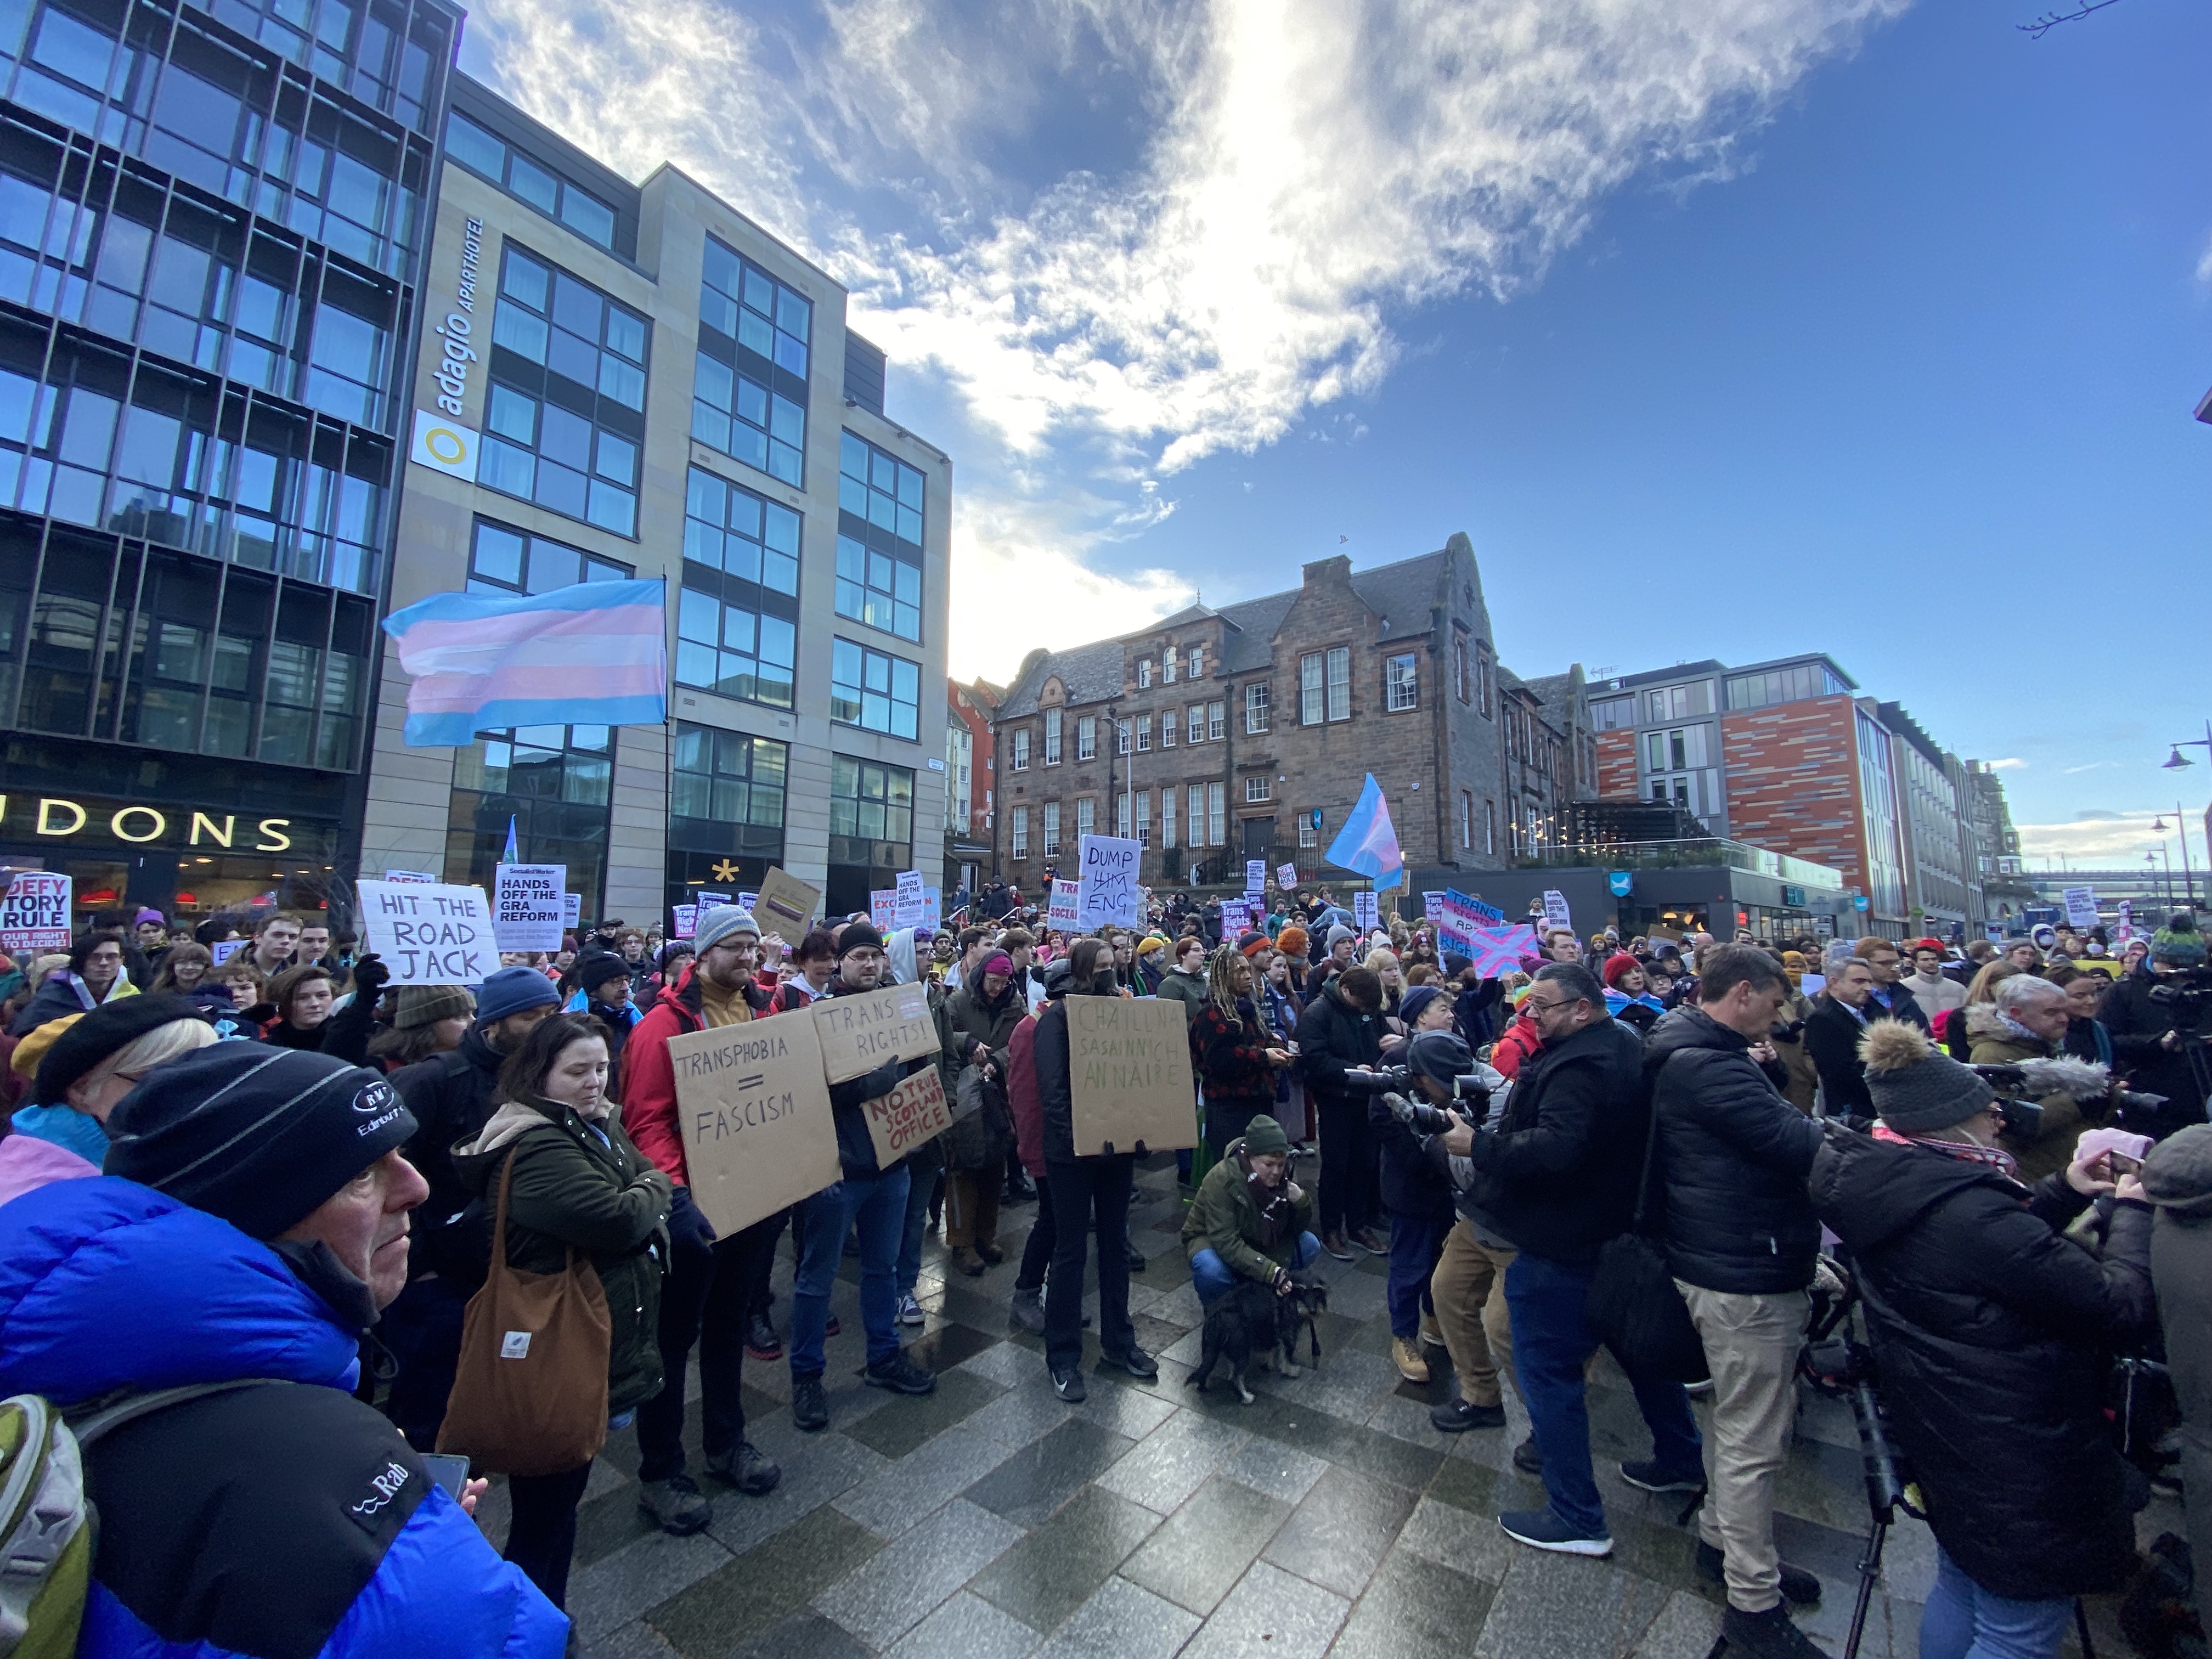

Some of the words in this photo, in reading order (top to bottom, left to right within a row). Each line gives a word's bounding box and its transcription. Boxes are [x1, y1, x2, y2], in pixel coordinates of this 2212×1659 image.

[433, 313, 477, 416] adagio
[458, 216, 484, 313] APARTHOTEL
[1088, 847, 1133, 868] DUMP
[1278, 866, 1292, 875] DEFY
[1279, 871, 1294, 879] TORY
[1280, 876, 1295, 884] RULE
[7, 879, 66, 895] DEFY
[501, 879, 550, 889] HANDS
[899, 880, 917, 888] HANDS
[1060, 882, 1078, 895] TRA
[1093, 871, 1128, 892] HIM
[6, 895, 66, 911] TORY
[501, 890, 528, 899] OFF
[532, 891, 557, 899] THE
[872, 891, 896, 899] TRAN
[898, 899, 921, 908] REFORM
[380, 894, 419, 915] HIT
[432, 897, 477, 917] THE
[500, 901, 530, 910] GRA
[1087, 894, 1127, 916] ENG
[1222, 906, 1244, 916] Trans
[1426, 904, 1442, 912] Right
[1451, 891, 1497, 921] TRANS
[4, 911, 64, 928] RULE
[500, 912, 558, 921] REFORM
[677, 917, 694, 927] Righ
[1224, 916, 1250, 928] Rights
[1454, 906, 1489, 927] RIGHTS
[393, 921, 476, 945] ROAD
[1224, 927, 1242, 938] Now
[1447, 927, 1469, 944] HUM
[1441, 934, 1472, 956] RIGH
[398, 950, 482, 979] JACK
[820, 998, 894, 1034] TRANS
[1156, 1004, 1180, 1029] NA
[856, 1020, 927, 1058] RIGHTS!
[675, 1037, 788, 1080] TRANSPHOBIA
[1084, 1060, 1107, 1090] AN
[869, 1090, 904, 1122] NO
[904, 1073, 939, 1098] TRUE
[697, 1092, 794, 1144] FASCISM
[885, 1084, 943, 1134] SCOTLAND
[890, 1108, 944, 1150] OFFICE
[371, 1462, 409, 1499] Rab
